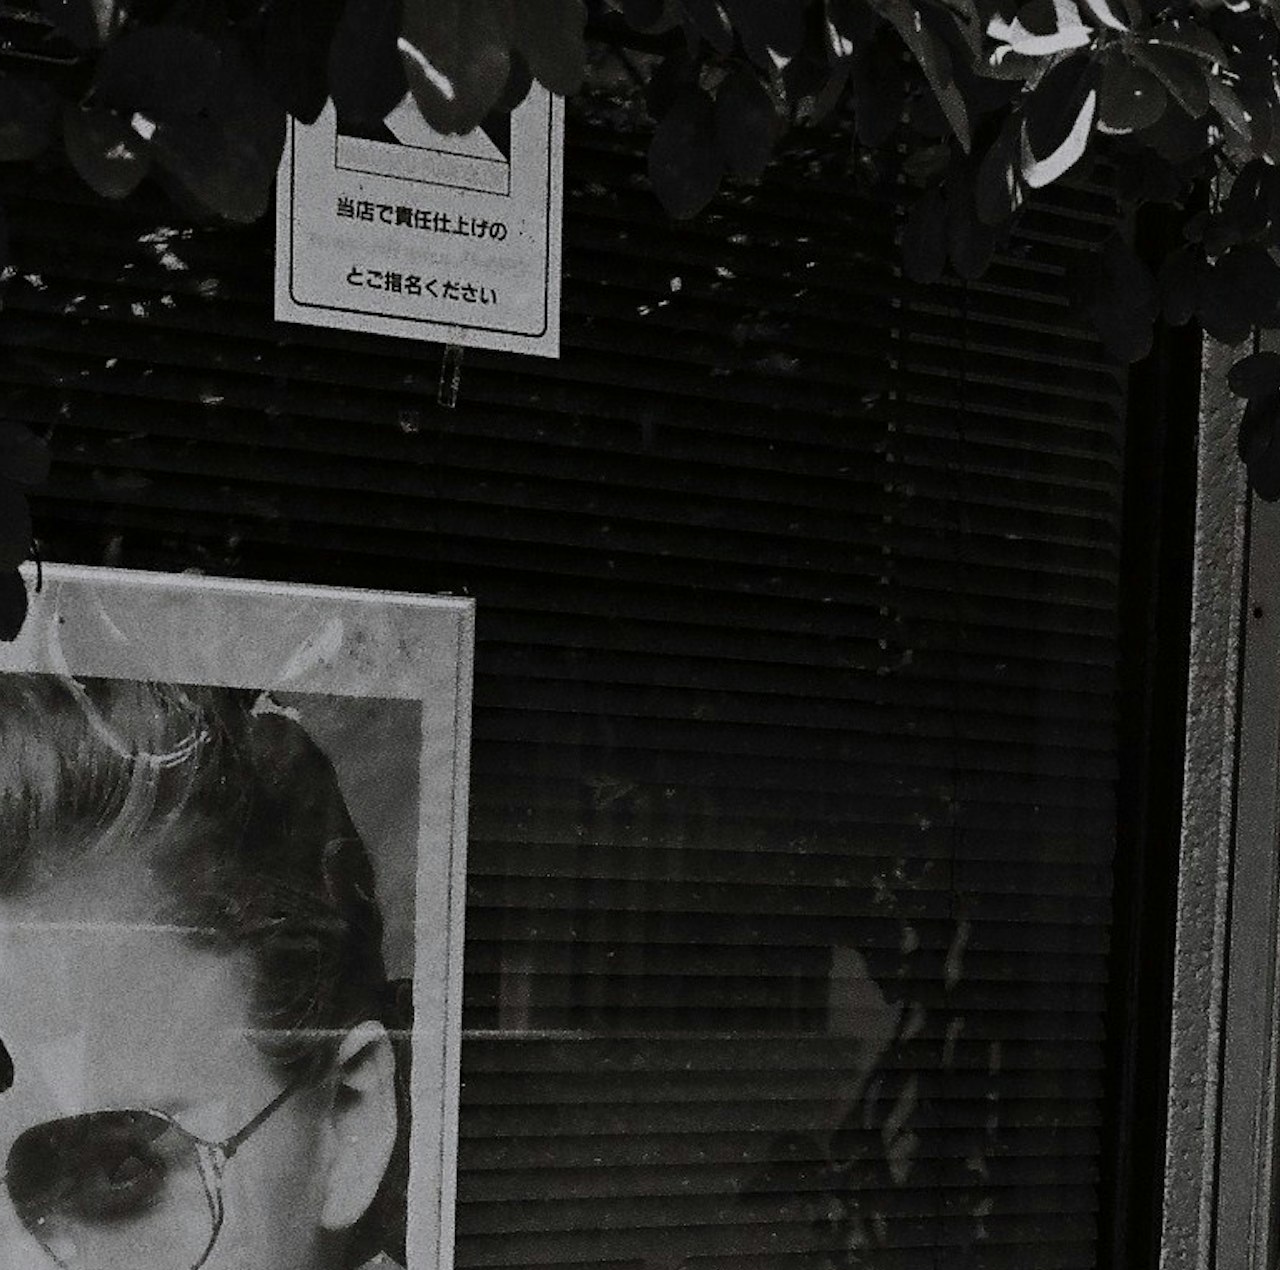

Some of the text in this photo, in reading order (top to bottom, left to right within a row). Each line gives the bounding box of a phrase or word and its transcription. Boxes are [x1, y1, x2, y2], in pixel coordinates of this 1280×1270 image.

[336, 196, 508, 242] 当店で責任仕上げの
[346, 265, 498, 305] とご指名ください
